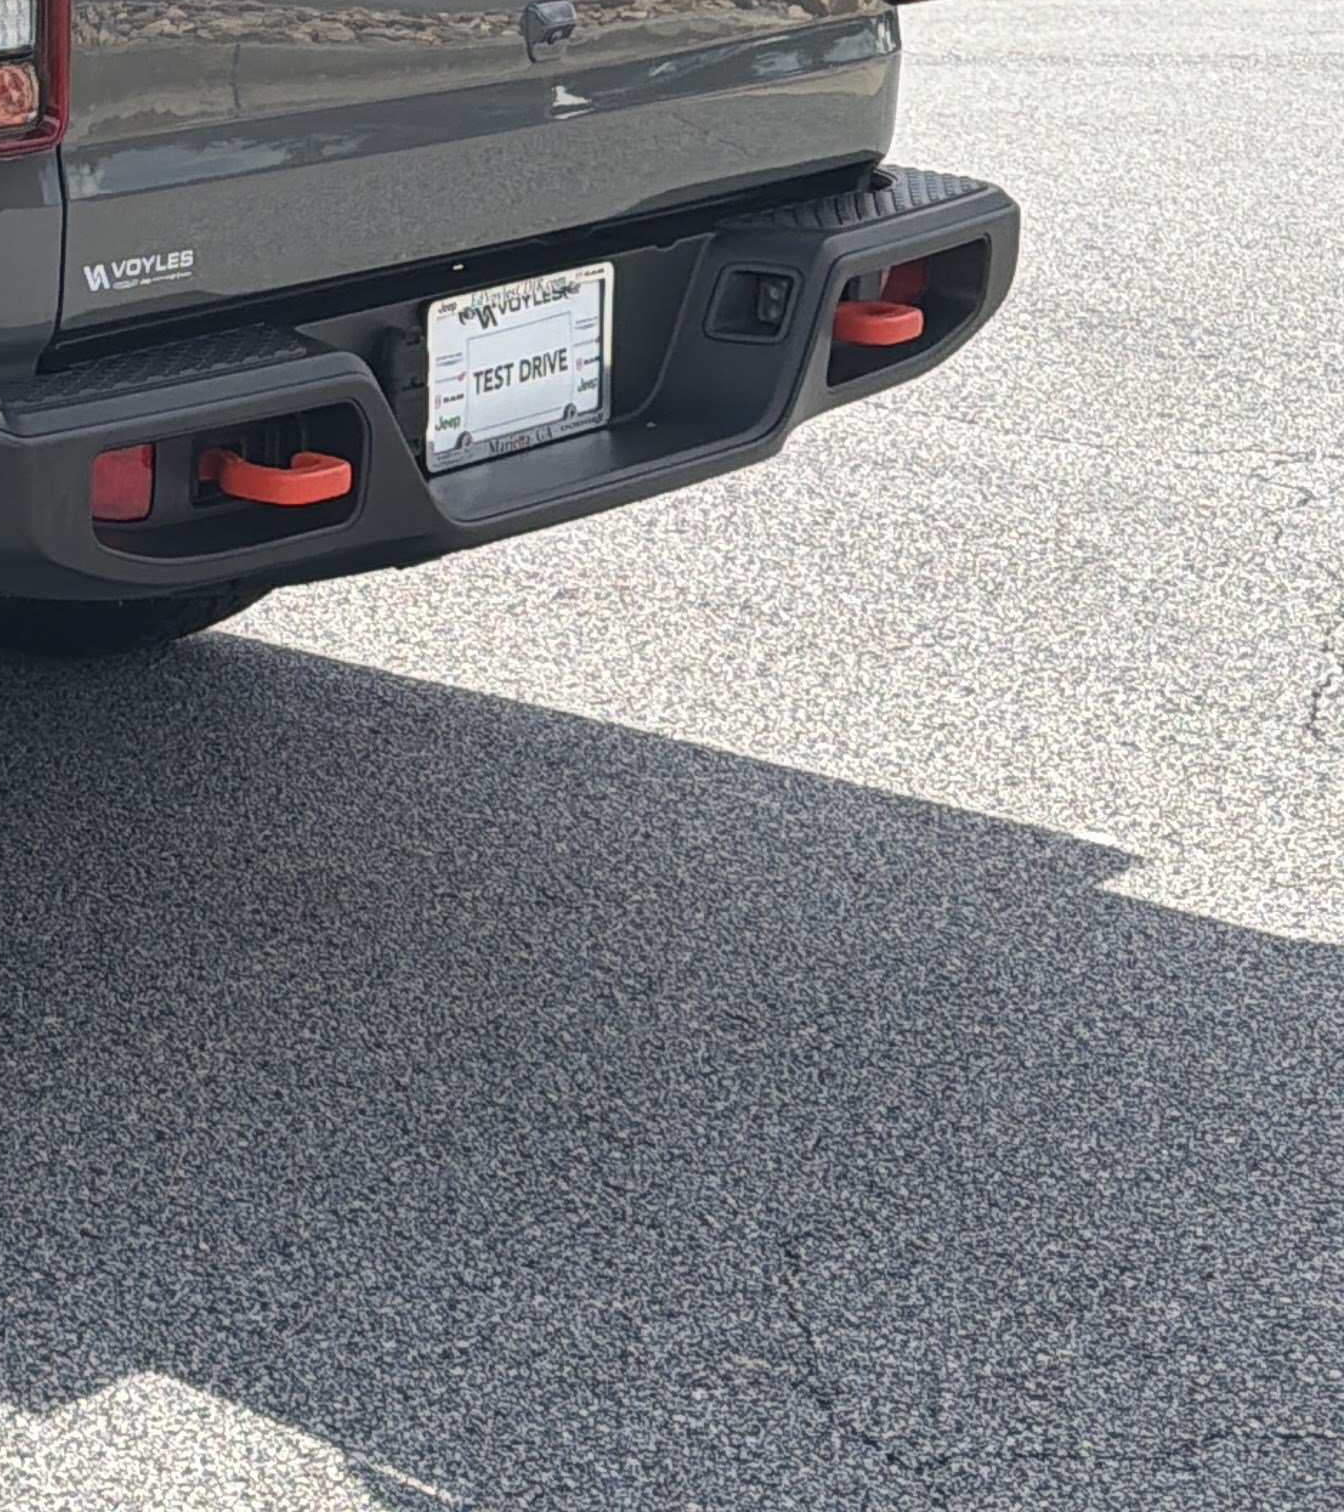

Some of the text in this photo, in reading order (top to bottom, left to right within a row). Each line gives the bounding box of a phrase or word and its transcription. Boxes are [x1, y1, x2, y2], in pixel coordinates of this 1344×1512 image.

[112, 249, 193, 279] VOYLES
[473, 347, 568, 395] TEST DRIVE
